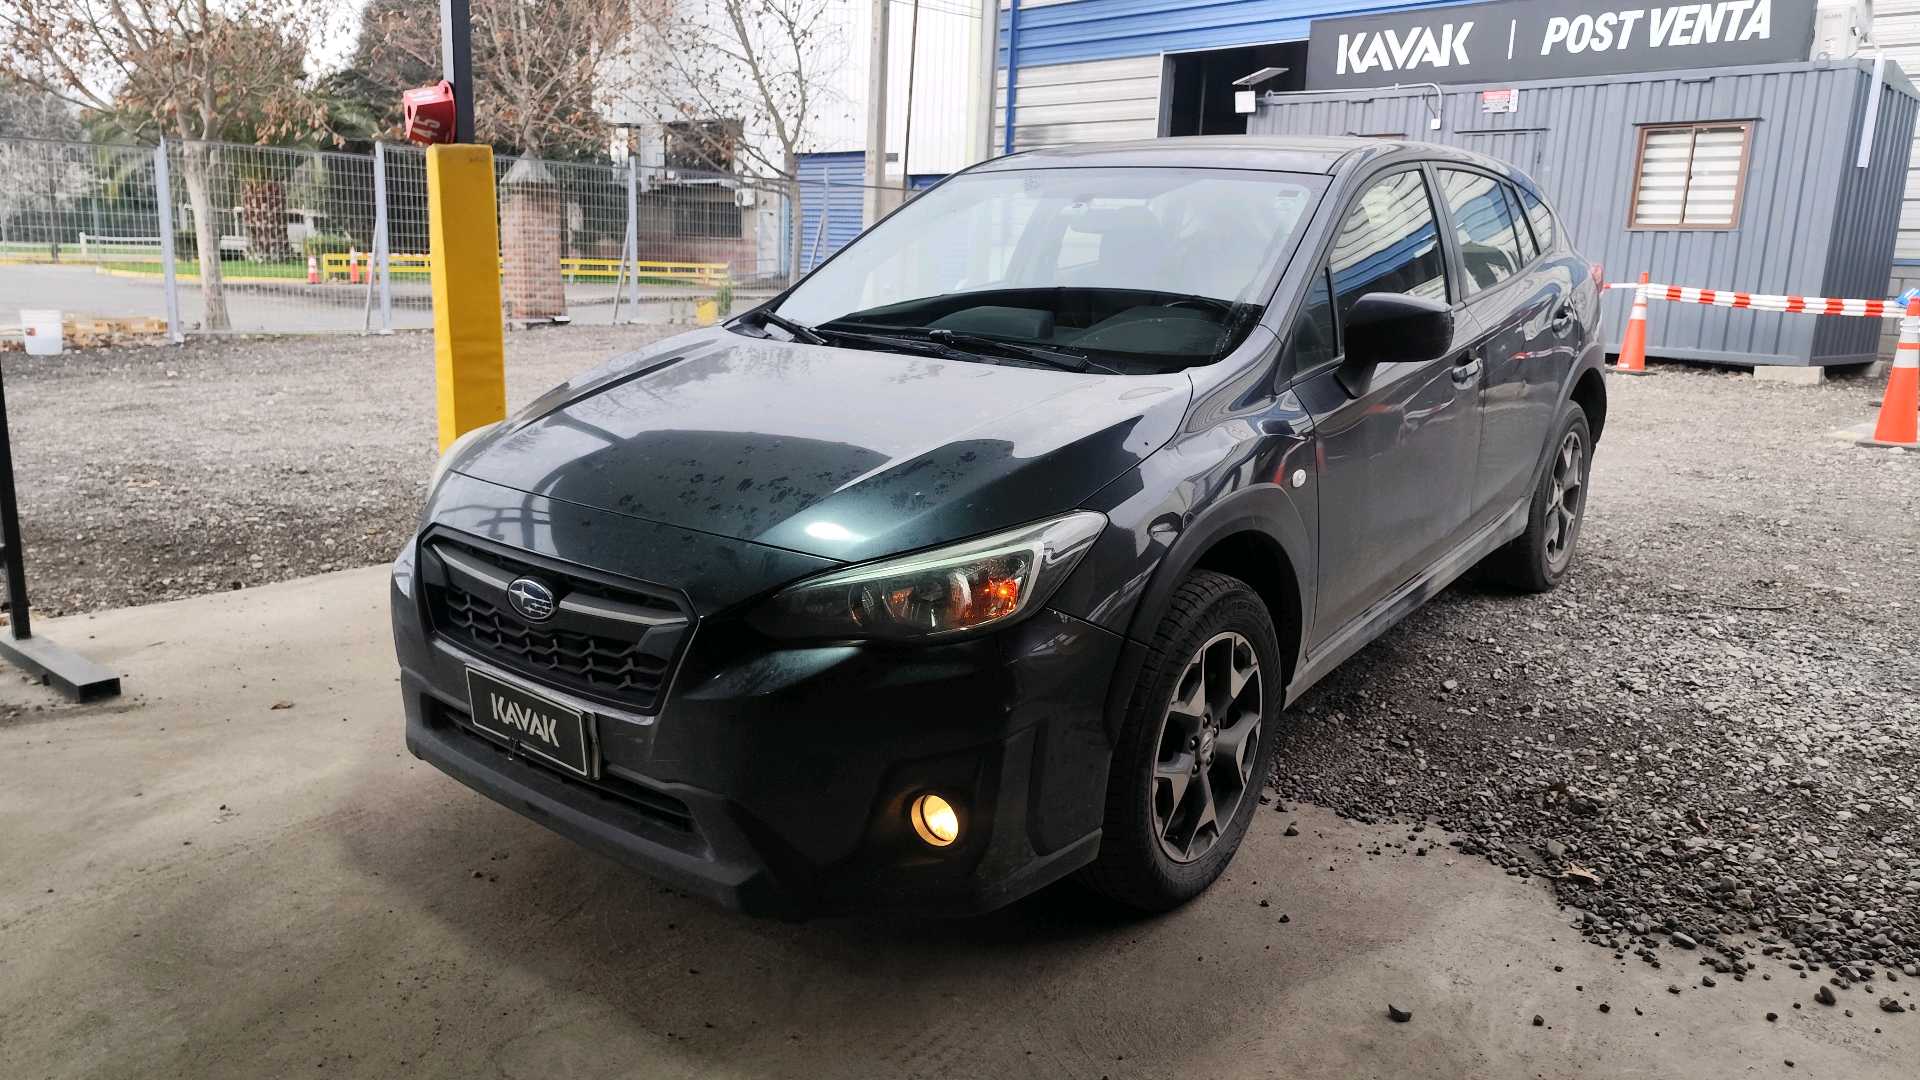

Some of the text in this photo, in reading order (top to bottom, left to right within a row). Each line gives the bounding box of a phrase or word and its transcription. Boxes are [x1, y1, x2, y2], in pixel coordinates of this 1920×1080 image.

[1336, 0, 1772, 75] KAVAK POST VENTA
[490, 692, 560, 748] KAVAK
